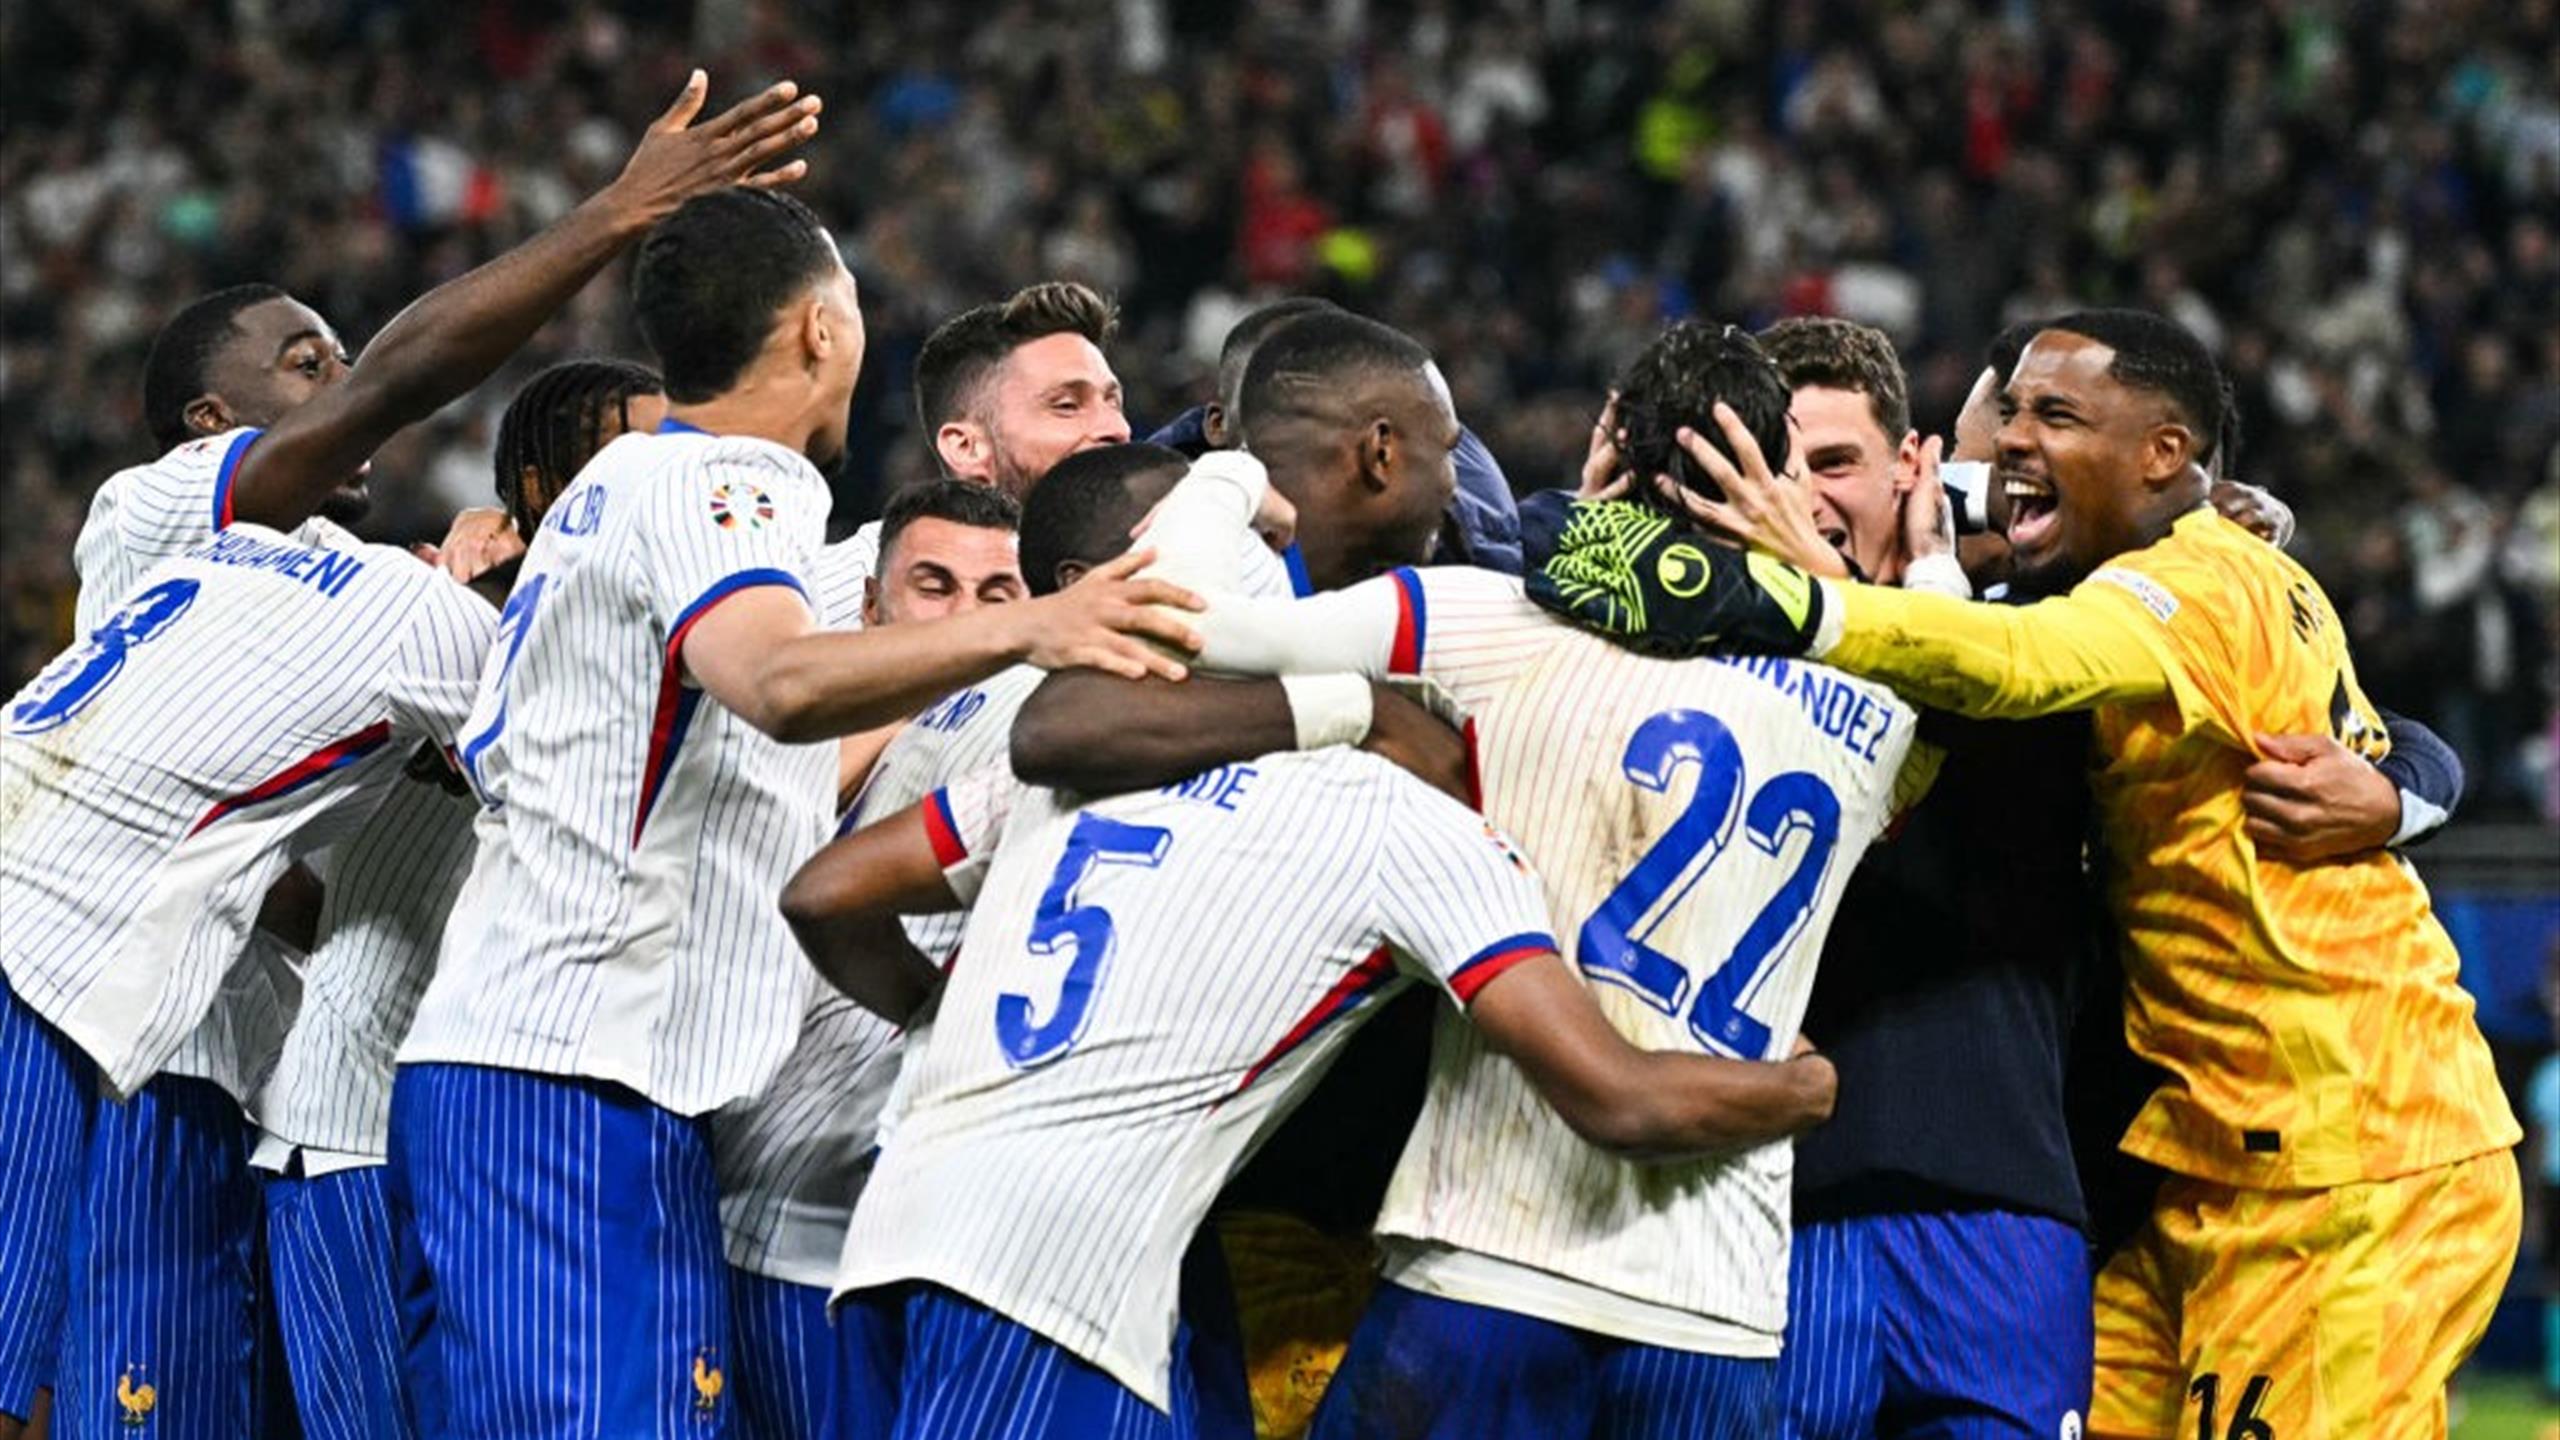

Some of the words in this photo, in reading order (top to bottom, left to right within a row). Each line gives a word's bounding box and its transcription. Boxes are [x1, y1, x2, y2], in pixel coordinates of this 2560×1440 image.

[995, 812, 1173, 1073] 5
[1577, 708, 1842, 1062] 22
[2189, 1373, 2275, 1440] 16
